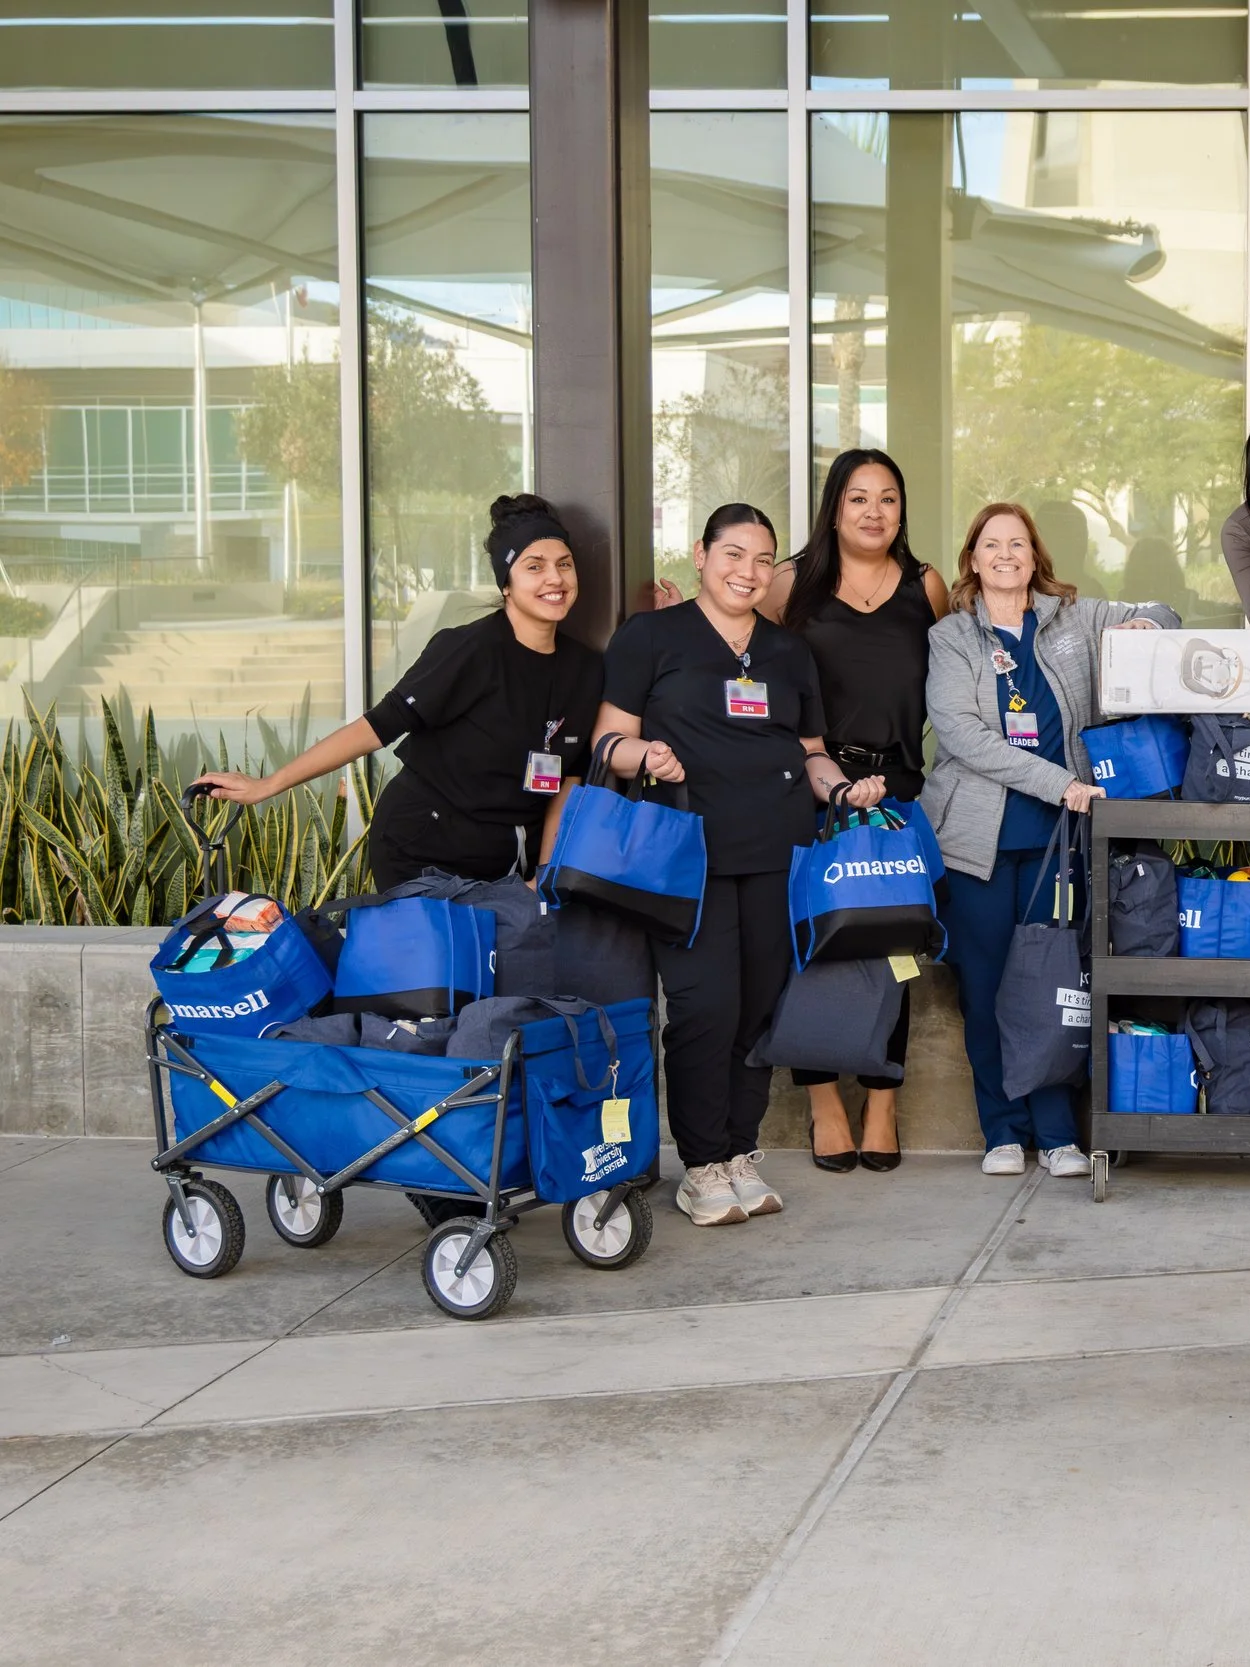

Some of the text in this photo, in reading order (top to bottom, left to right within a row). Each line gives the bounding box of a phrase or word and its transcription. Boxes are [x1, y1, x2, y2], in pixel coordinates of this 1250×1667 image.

[742, 705, 755, 713] RN
[1222, 765, 1228, 774] a
[541, 781, 550, 789] RN
[1063, 993, 1080, 1005] It's
[173, 989, 271, 1019] marsell
[1068, 1014, 1074, 1023] a
